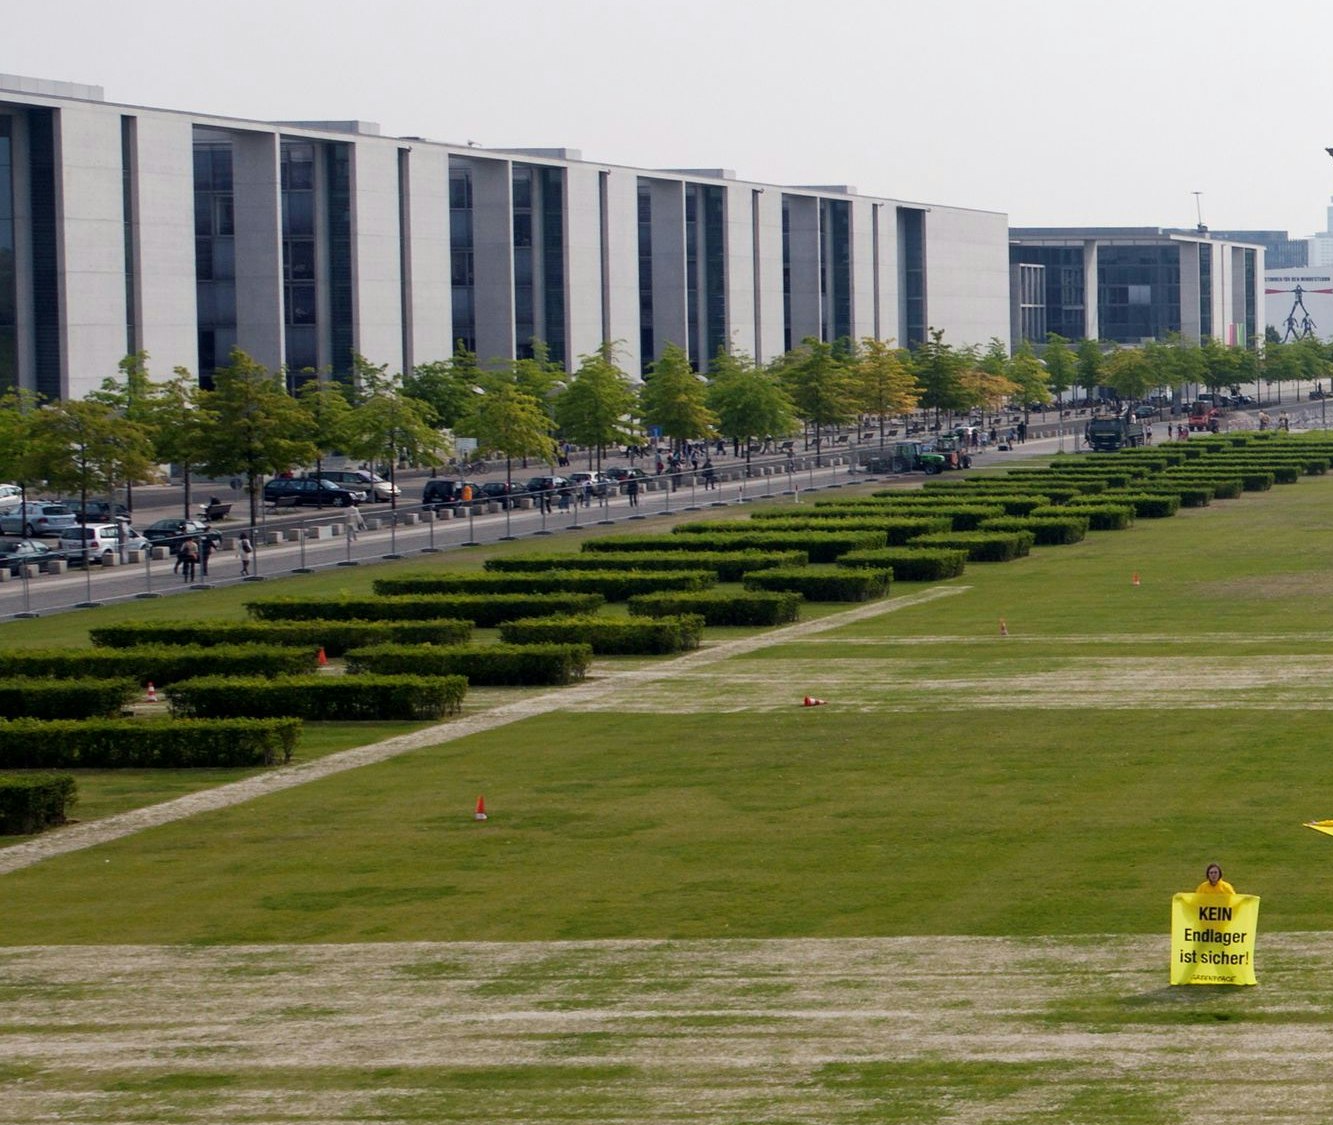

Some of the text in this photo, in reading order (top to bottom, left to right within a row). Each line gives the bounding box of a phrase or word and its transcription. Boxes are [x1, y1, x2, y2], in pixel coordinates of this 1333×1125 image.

[1199, 906, 1232, 921] KEIN
[1184, 928, 1247, 946] Endlager
[1180, 950, 1249, 965] ist sicher!
